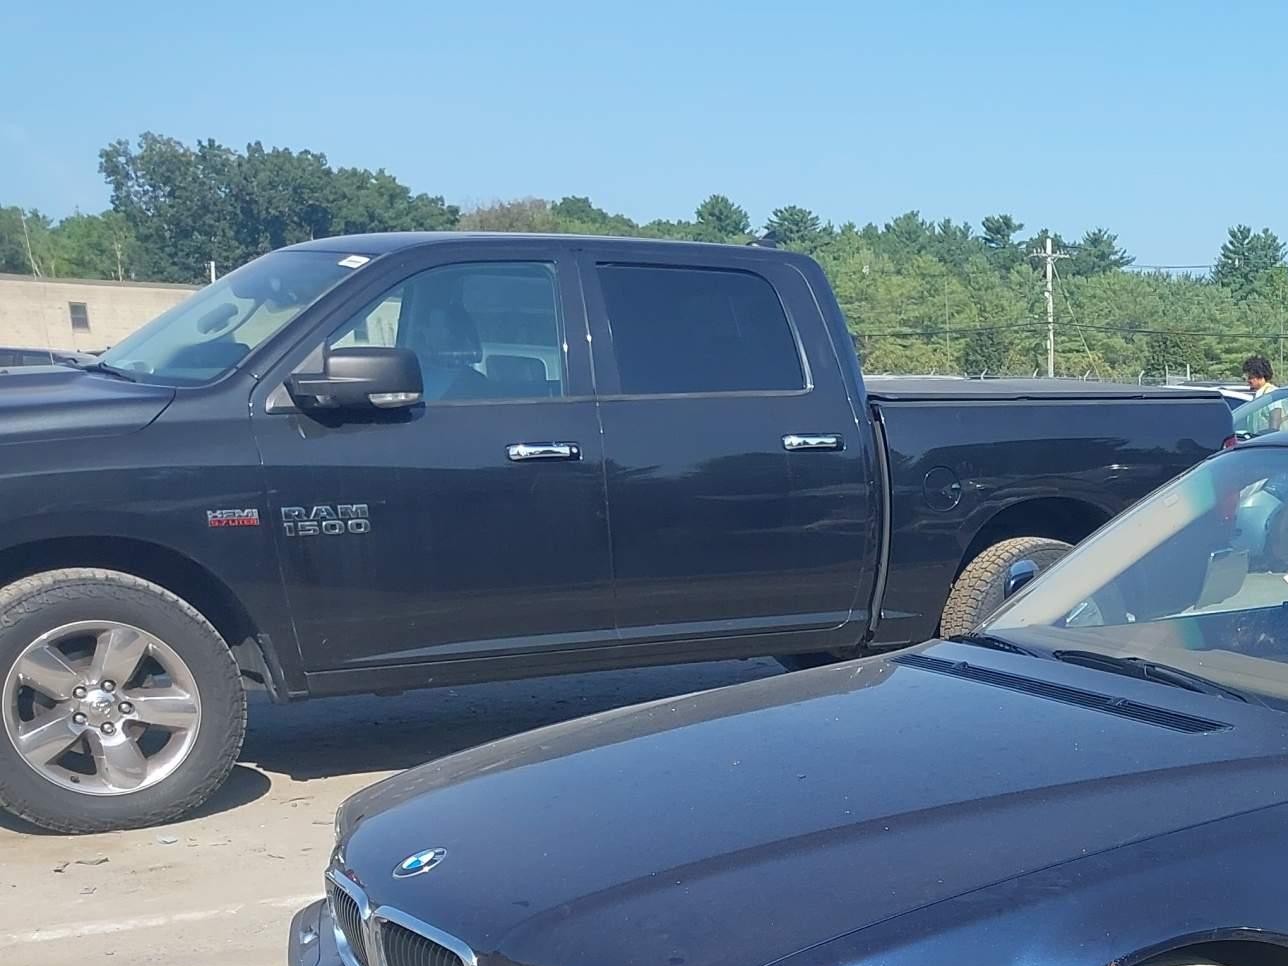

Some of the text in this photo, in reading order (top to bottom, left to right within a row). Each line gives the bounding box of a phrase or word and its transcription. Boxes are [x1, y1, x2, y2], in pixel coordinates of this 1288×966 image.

[206, 509, 257, 518] HEMI
[281, 504, 369, 521] RAM
[283, 519, 371, 537] 1500
